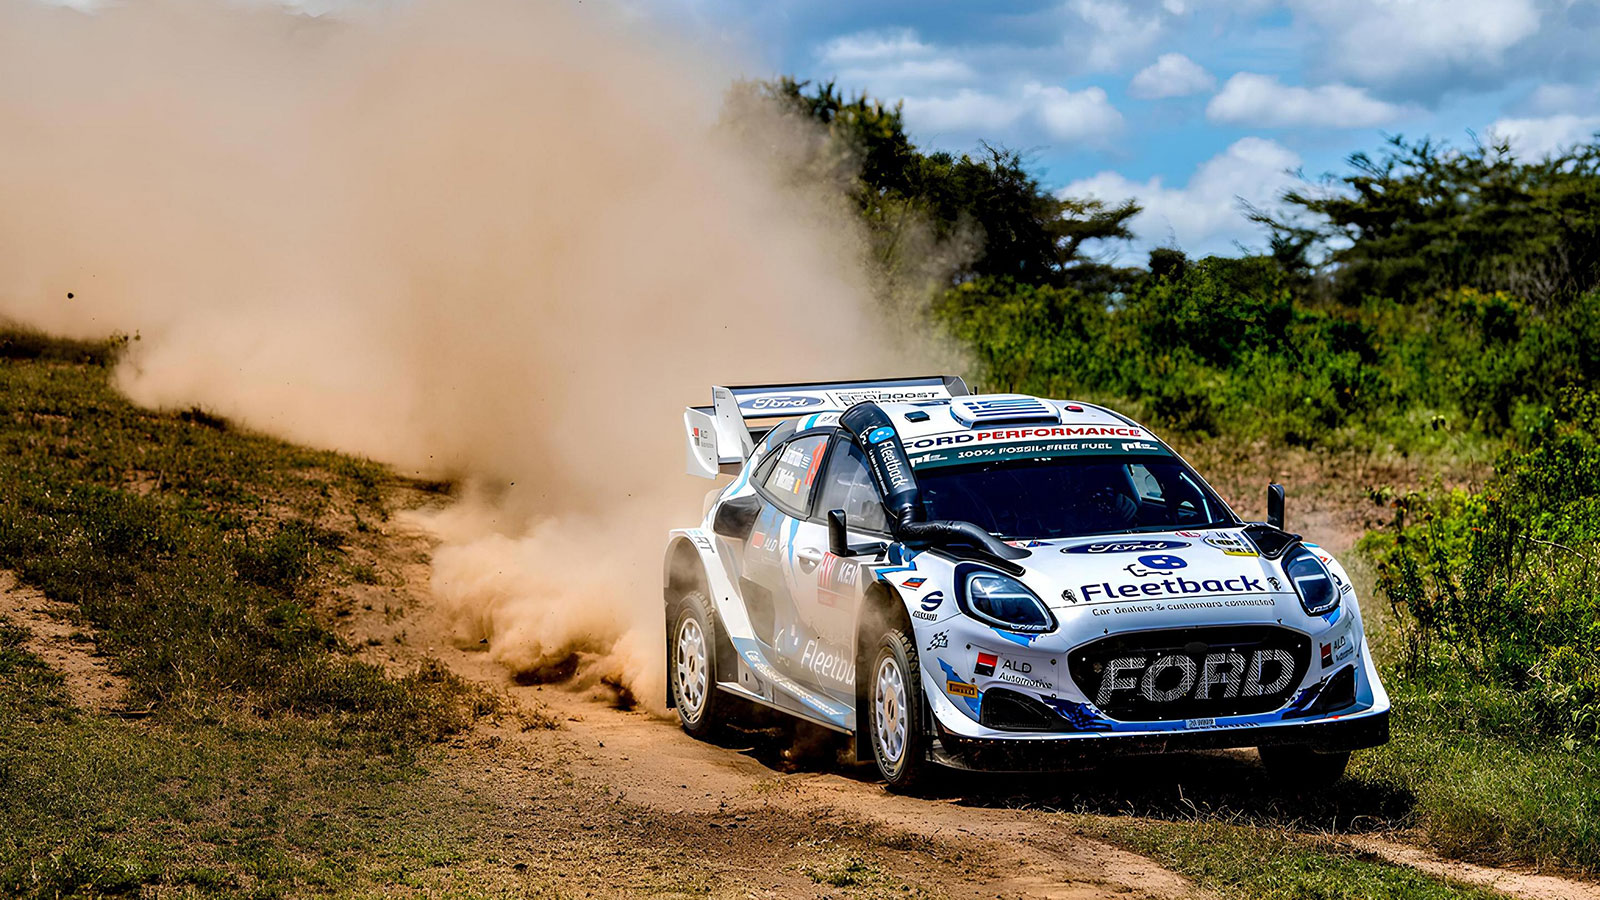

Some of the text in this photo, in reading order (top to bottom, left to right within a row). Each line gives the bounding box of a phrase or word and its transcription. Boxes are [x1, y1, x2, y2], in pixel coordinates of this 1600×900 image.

[752, 396, 809, 409] Ford
[903, 428, 1141, 449] FORD PERFORMANCE
[958, 448, 995, 459] 100%
[1081, 442, 1112, 450] FUEL
[877, 440, 909, 489] Fleetback
[1087, 541, 1168, 554] Ford
[1080, 575, 1265, 602] Fleetback
[1092, 607, 1111, 617] Car
[1114, 604, 1154, 615] dealers
[1156, 603, 1165, 611] &
[1002, 659, 1032, 674] ALD
[1095, 649, 1295, 706] FORD
